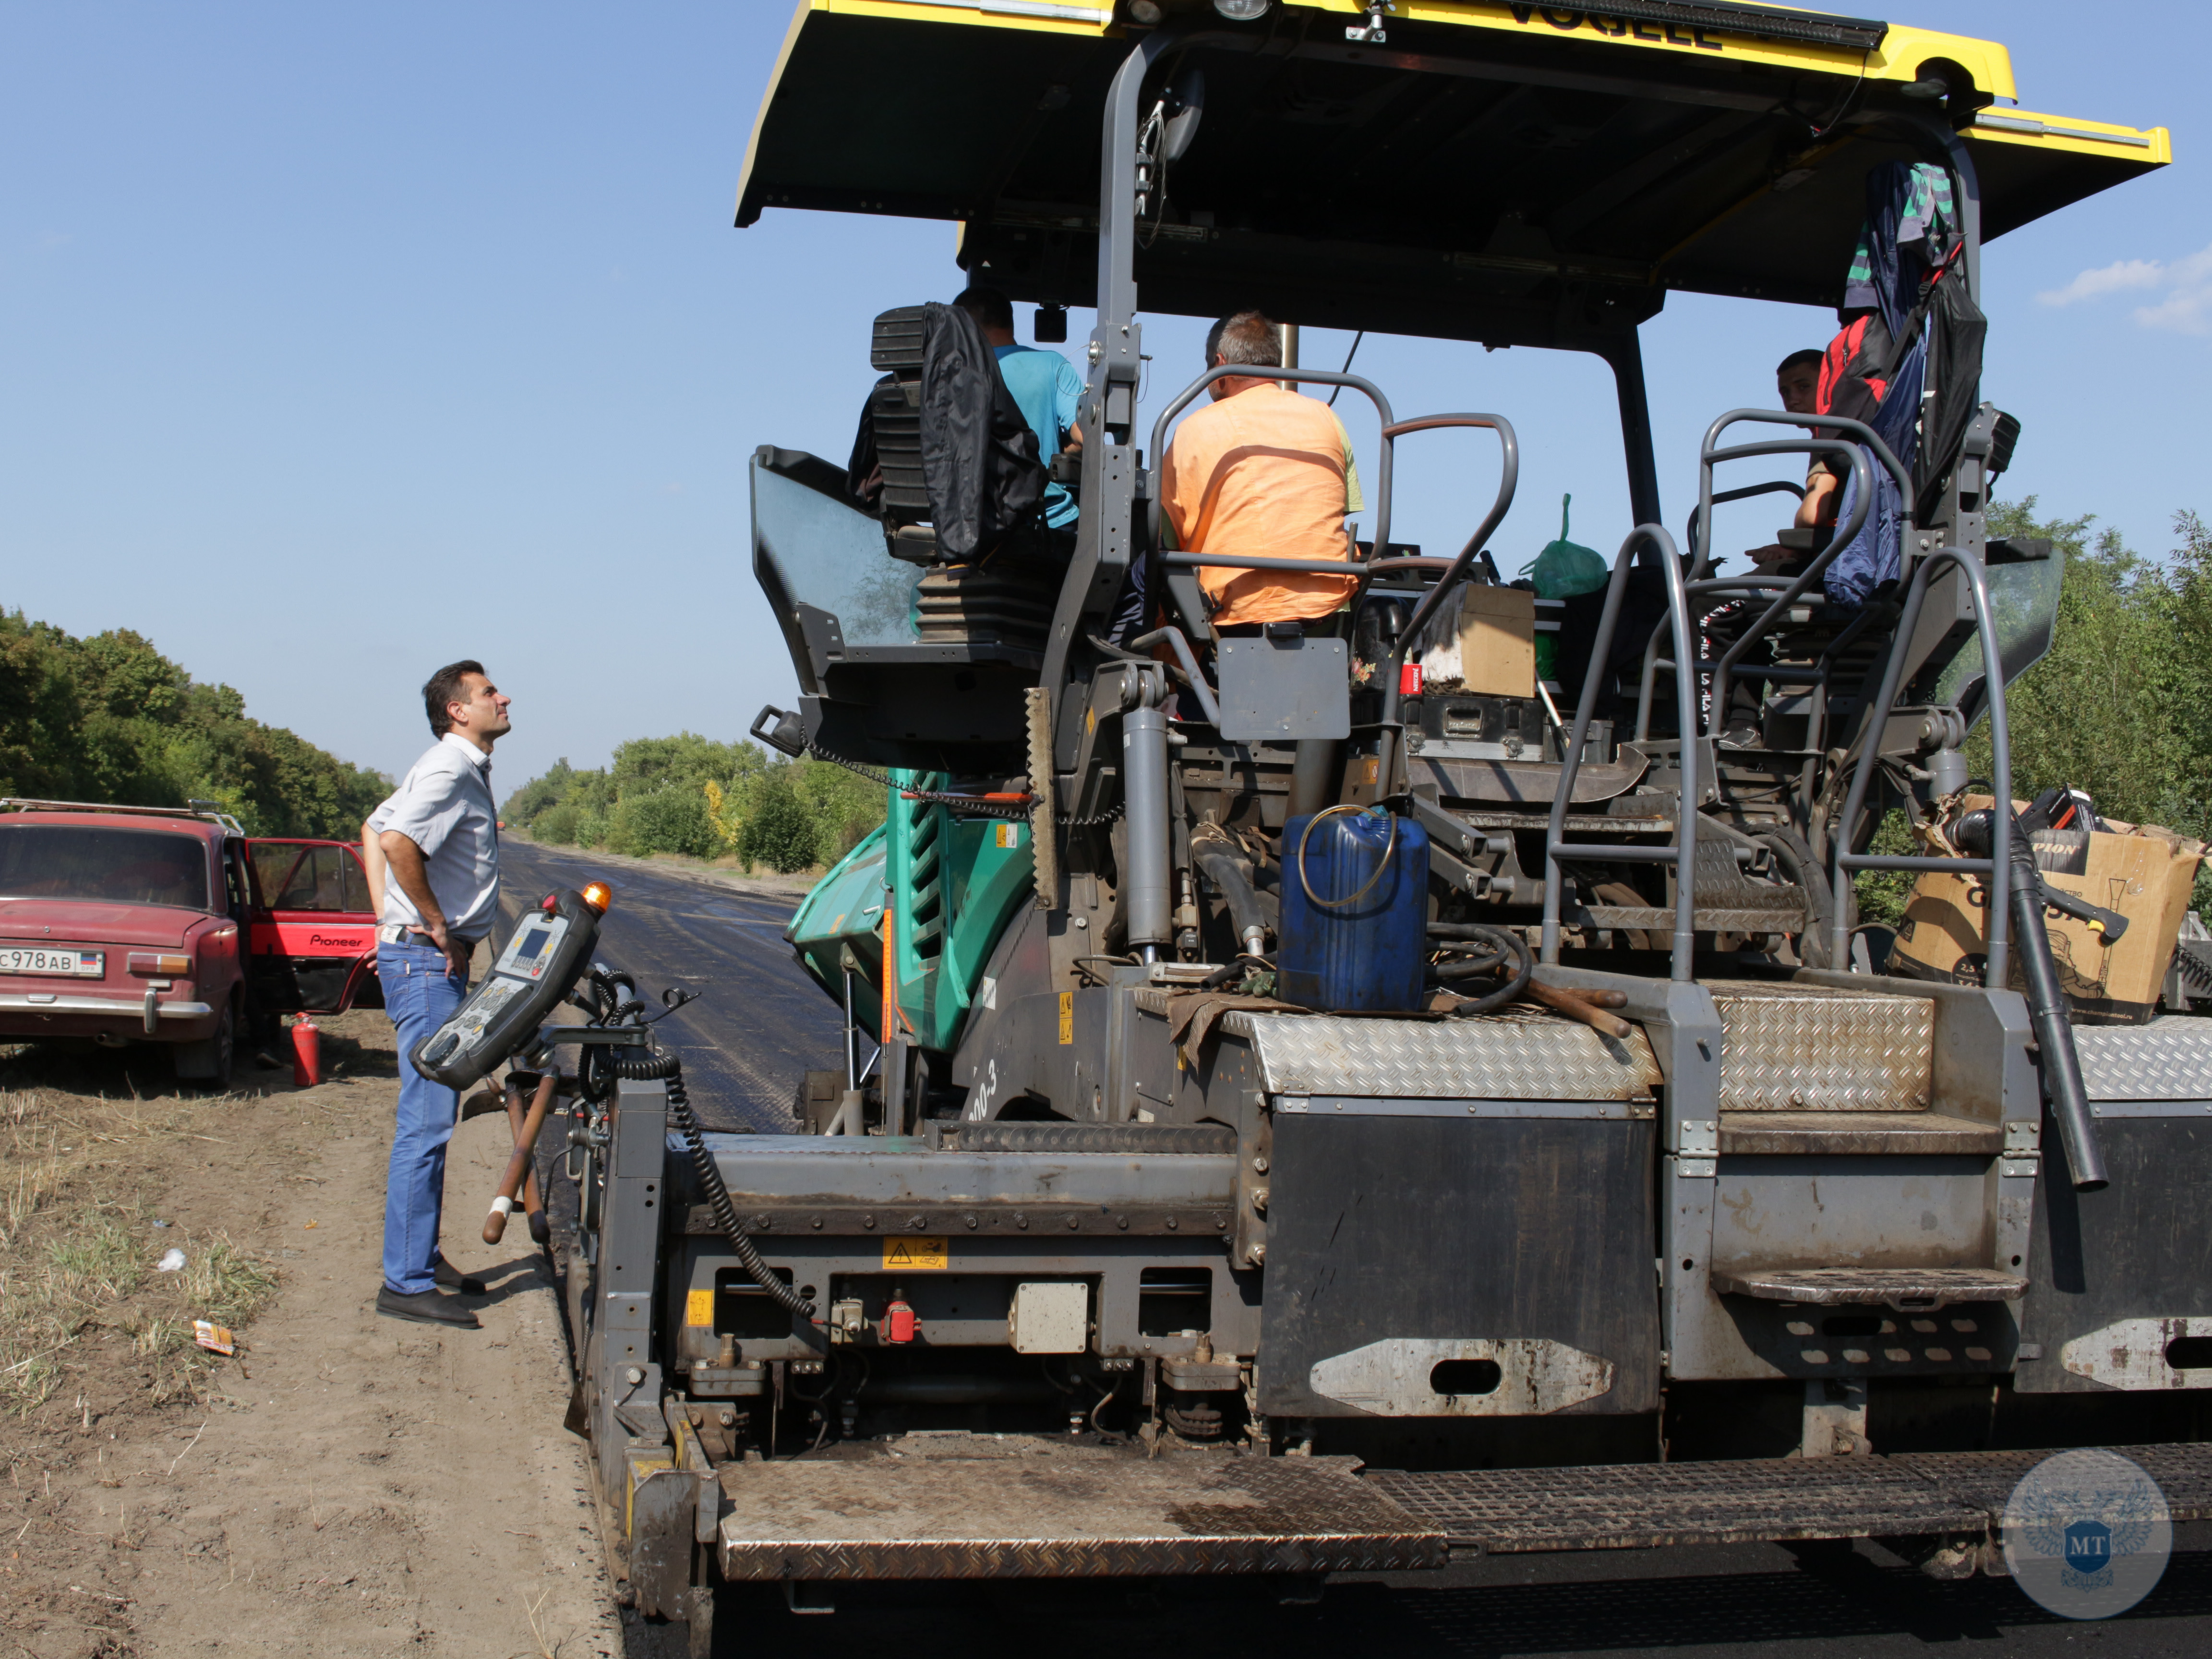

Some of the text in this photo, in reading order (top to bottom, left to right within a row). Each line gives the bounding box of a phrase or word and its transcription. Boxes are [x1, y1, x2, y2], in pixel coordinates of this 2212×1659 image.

[1701, 673, 1710, 685] LA
[2031, 842, 2078, 855] PION
[310, 934, 363, 947] Pioneer
